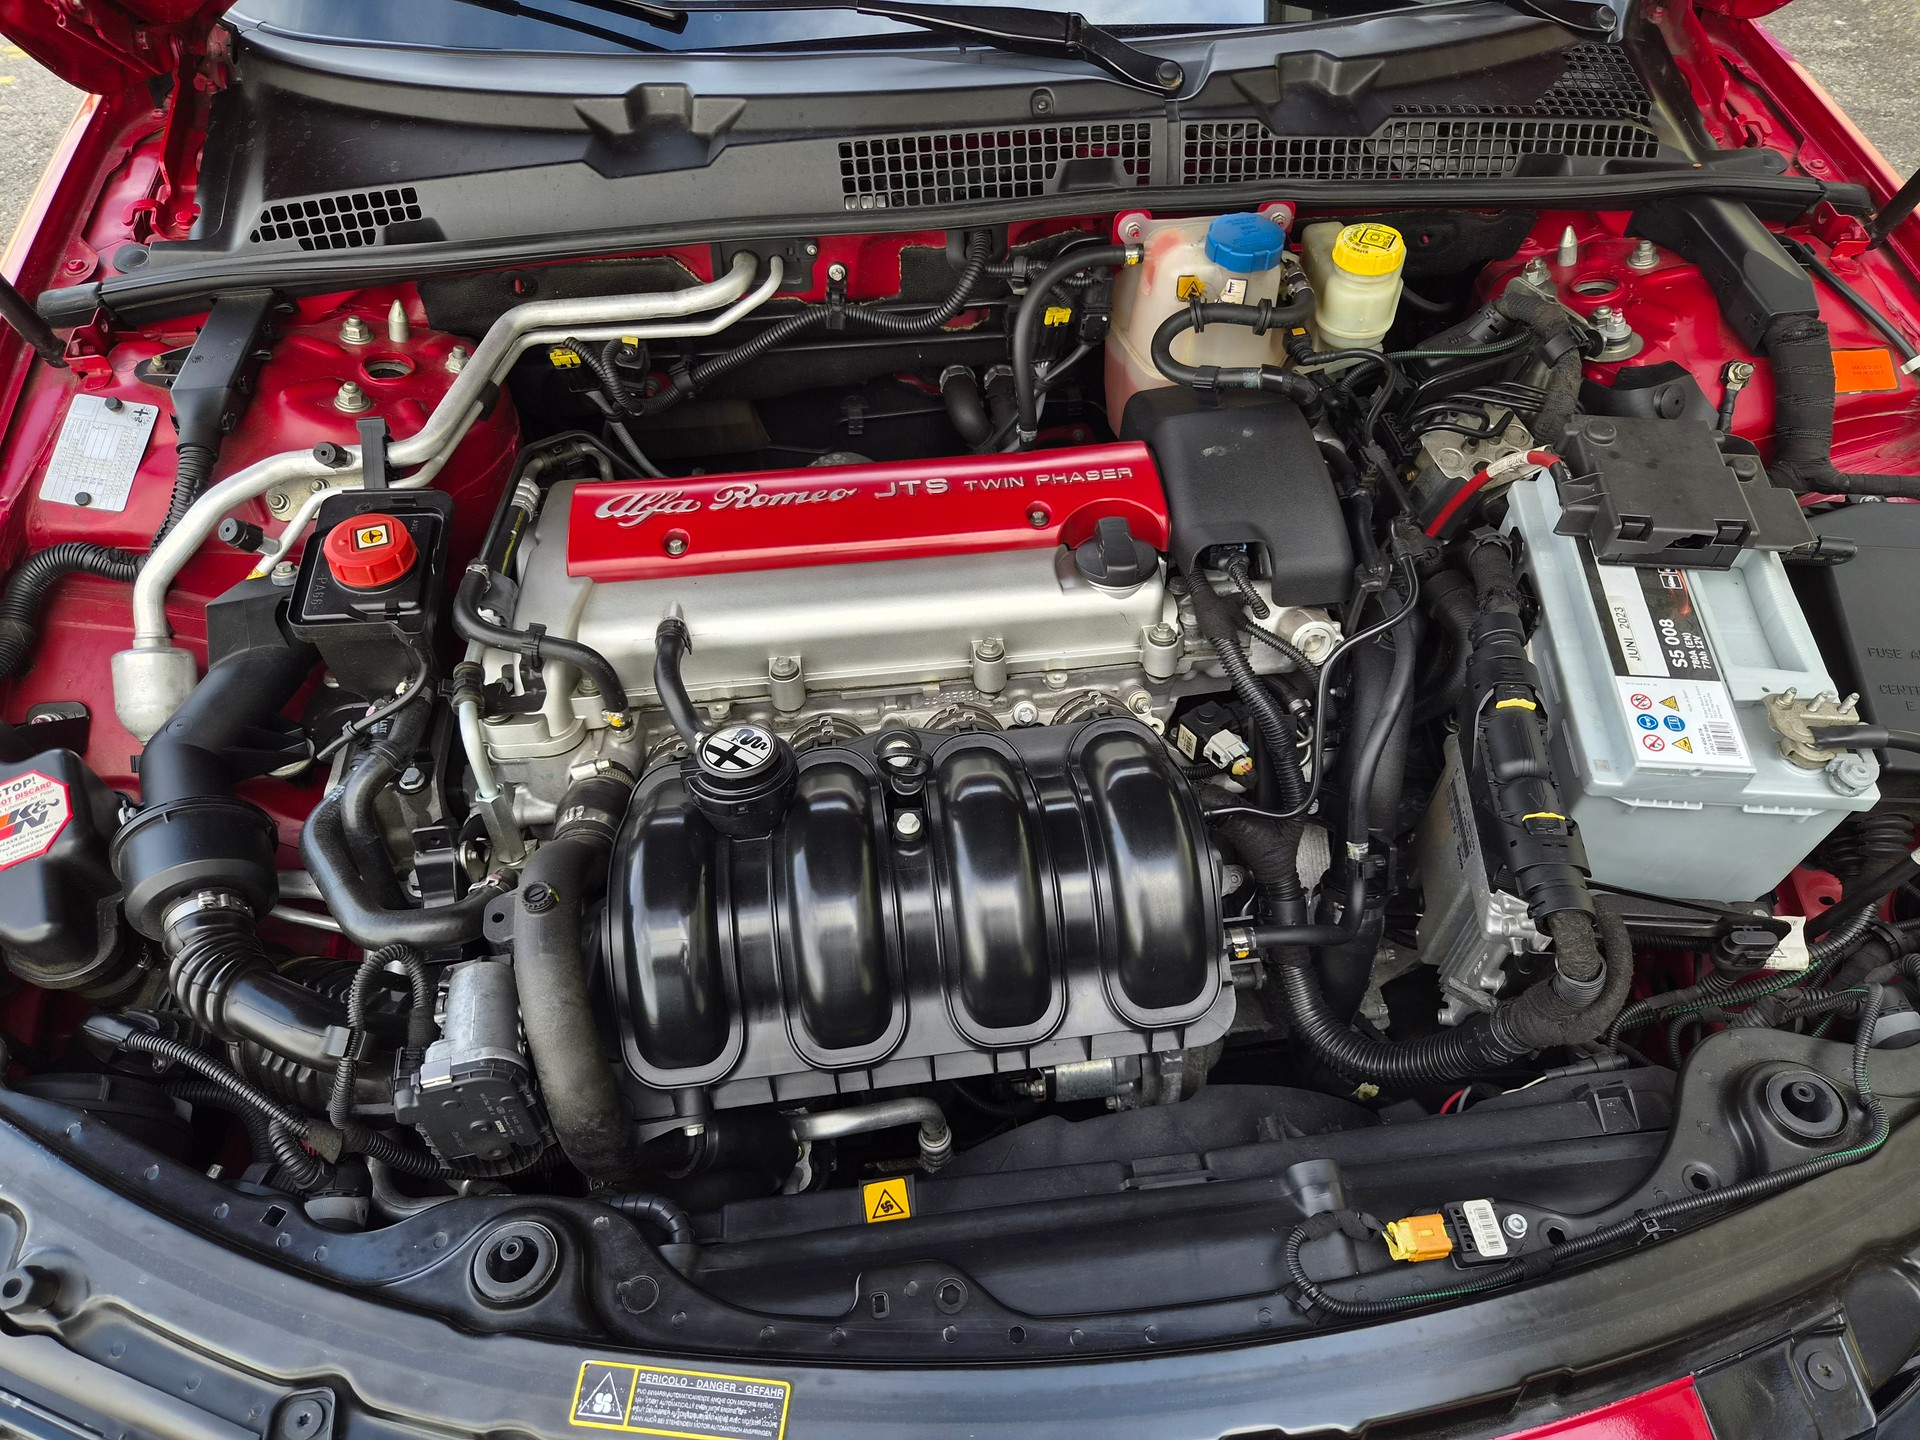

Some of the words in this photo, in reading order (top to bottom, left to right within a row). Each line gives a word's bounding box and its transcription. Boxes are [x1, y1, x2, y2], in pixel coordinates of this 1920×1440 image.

[595, 490, 701, 527] Alfa
[709, 483, 858, 511] Romeo
[874, 478, 949, 499] JTS
[963, 476, 1025, 491] TWIN
[1035, 467, 1133, 487] PHASER
[1614, 606, 1630, 629] 2023
[1658, 618, 1680, 646] 008
[1681, 632, 1696, 648] (EN)
[1692, 635, 1705, 650] 12V
[1623, 637, 1641, 661] JUNI
[1668, 649, 1689, 668] S5
[1688, 649, 1702, 669] 780A
[1698, 651, 1712, 669] 77Ah
[1867, 647, 1903, 660] FUSE
[0, 796, 12, 806] OT
[14, 781, 52, 800] DISCARD
[7, 798, 60, 836] K&N
[639, 1373, 687, 1387] PERICOLO
[696, 1379, 736, 1392] DANGER
[745, 1385, 784, 1398] GEFAHR
